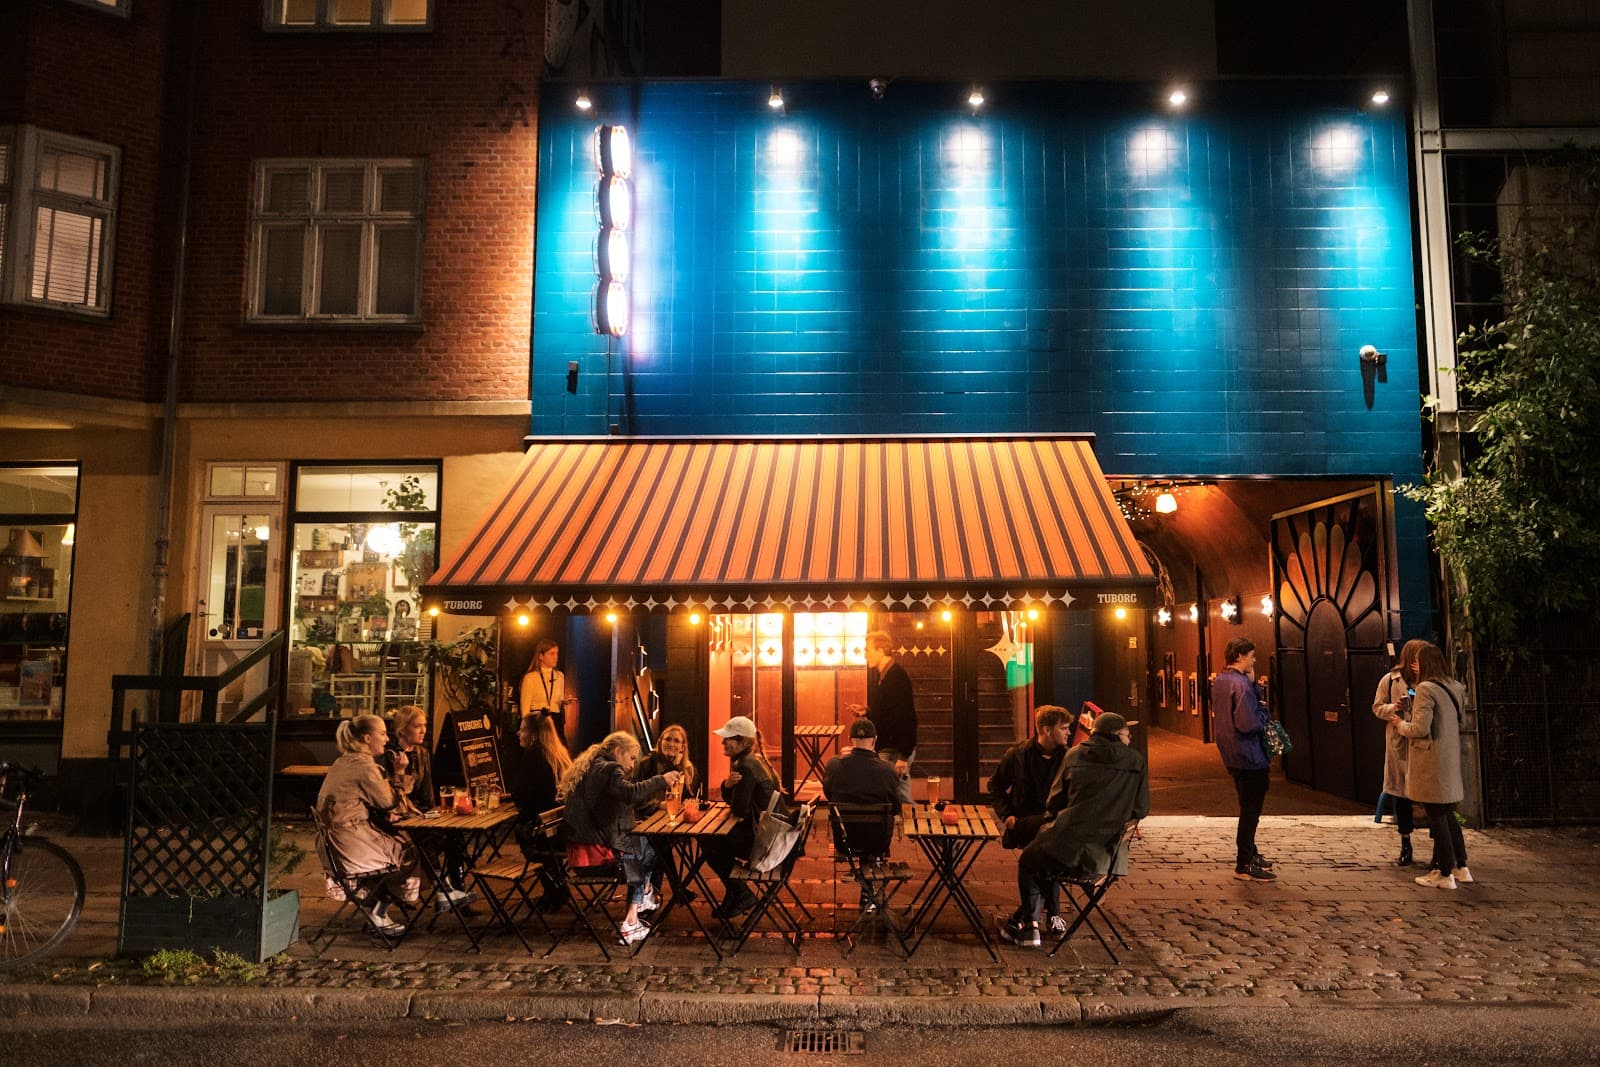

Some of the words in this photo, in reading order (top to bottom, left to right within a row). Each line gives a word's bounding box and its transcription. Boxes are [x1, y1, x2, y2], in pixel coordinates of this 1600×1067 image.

[1097, 593, 1137, 604] TUBORG
[443, 600, 483, 610] TUBORG
[457, 719, 483, 732] TUBORG
